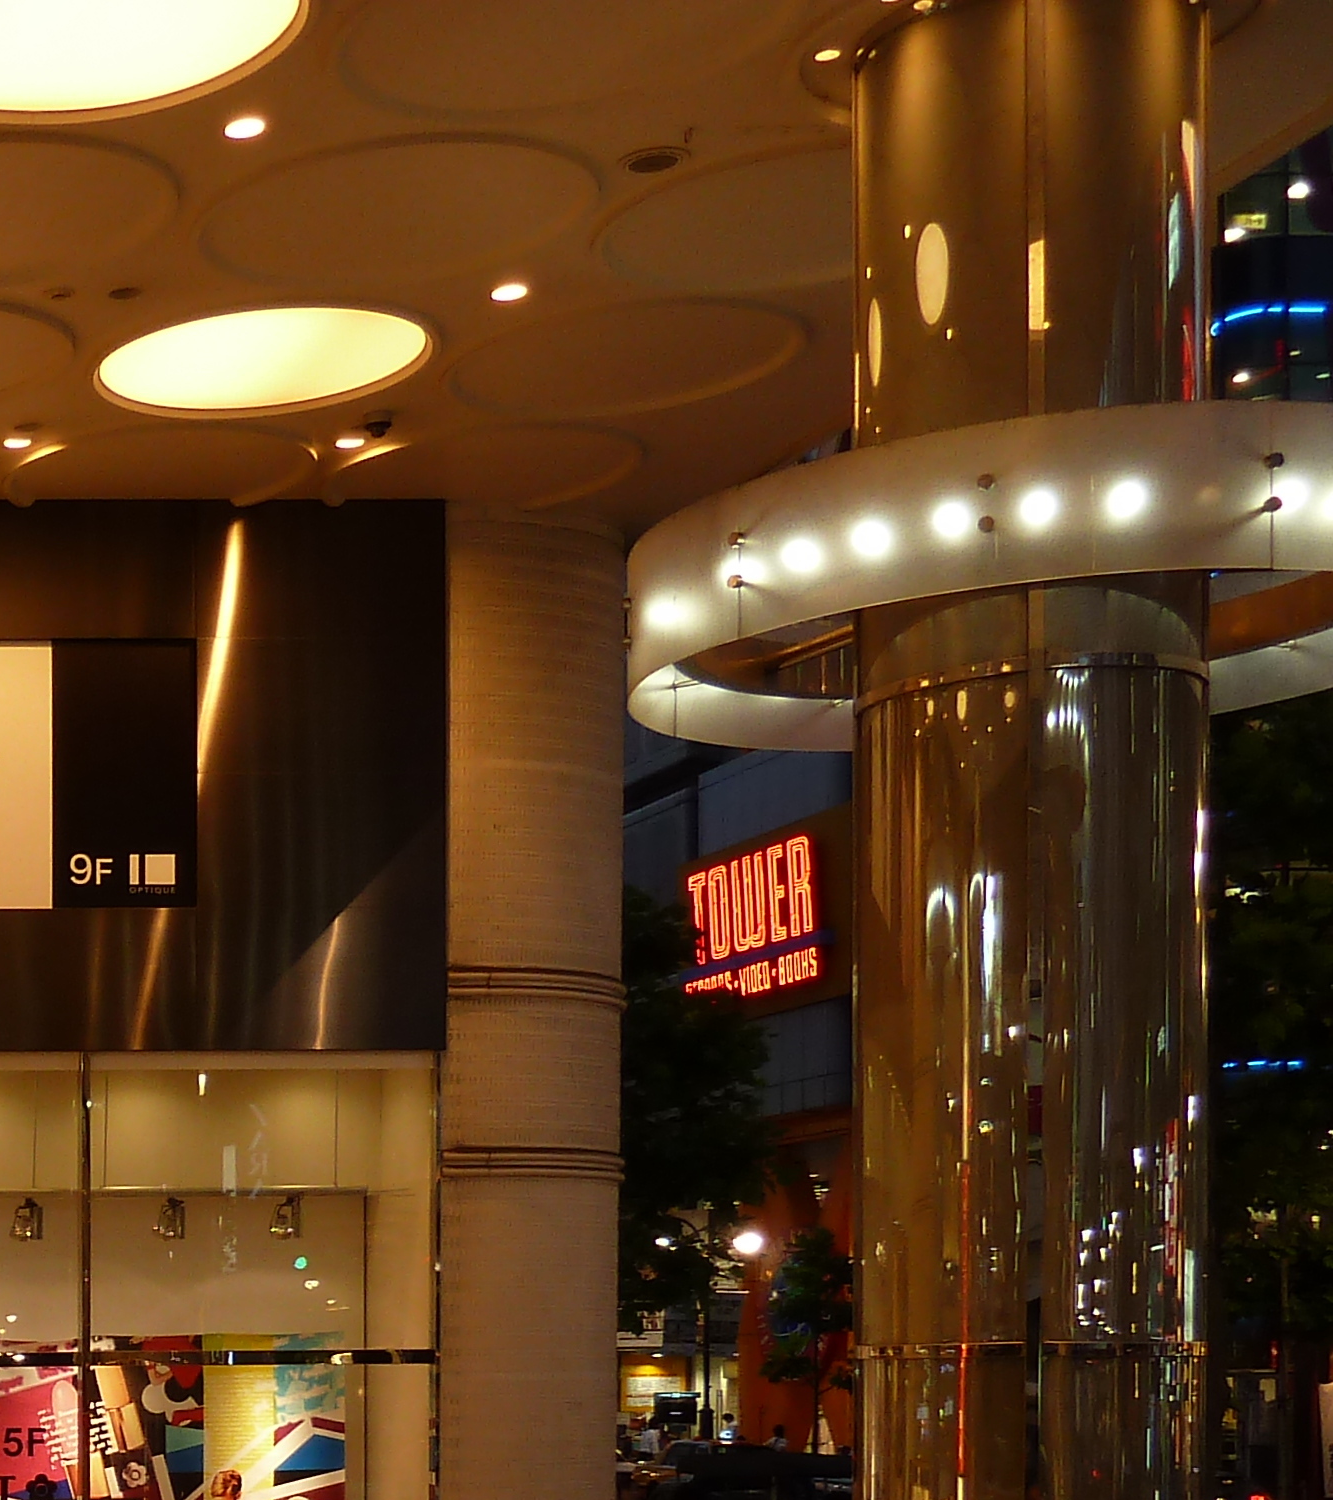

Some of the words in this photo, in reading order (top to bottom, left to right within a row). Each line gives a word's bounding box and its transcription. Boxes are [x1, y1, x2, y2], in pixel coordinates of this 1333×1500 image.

[69, 853, 113, 885] 9F
[129, 886, 176, 894] OPTIQUE
[688, 835, 814, 966] TOWER
[739, 961, 772, 996] VIDEO
[2, 1427, 47, 1457] 5F
